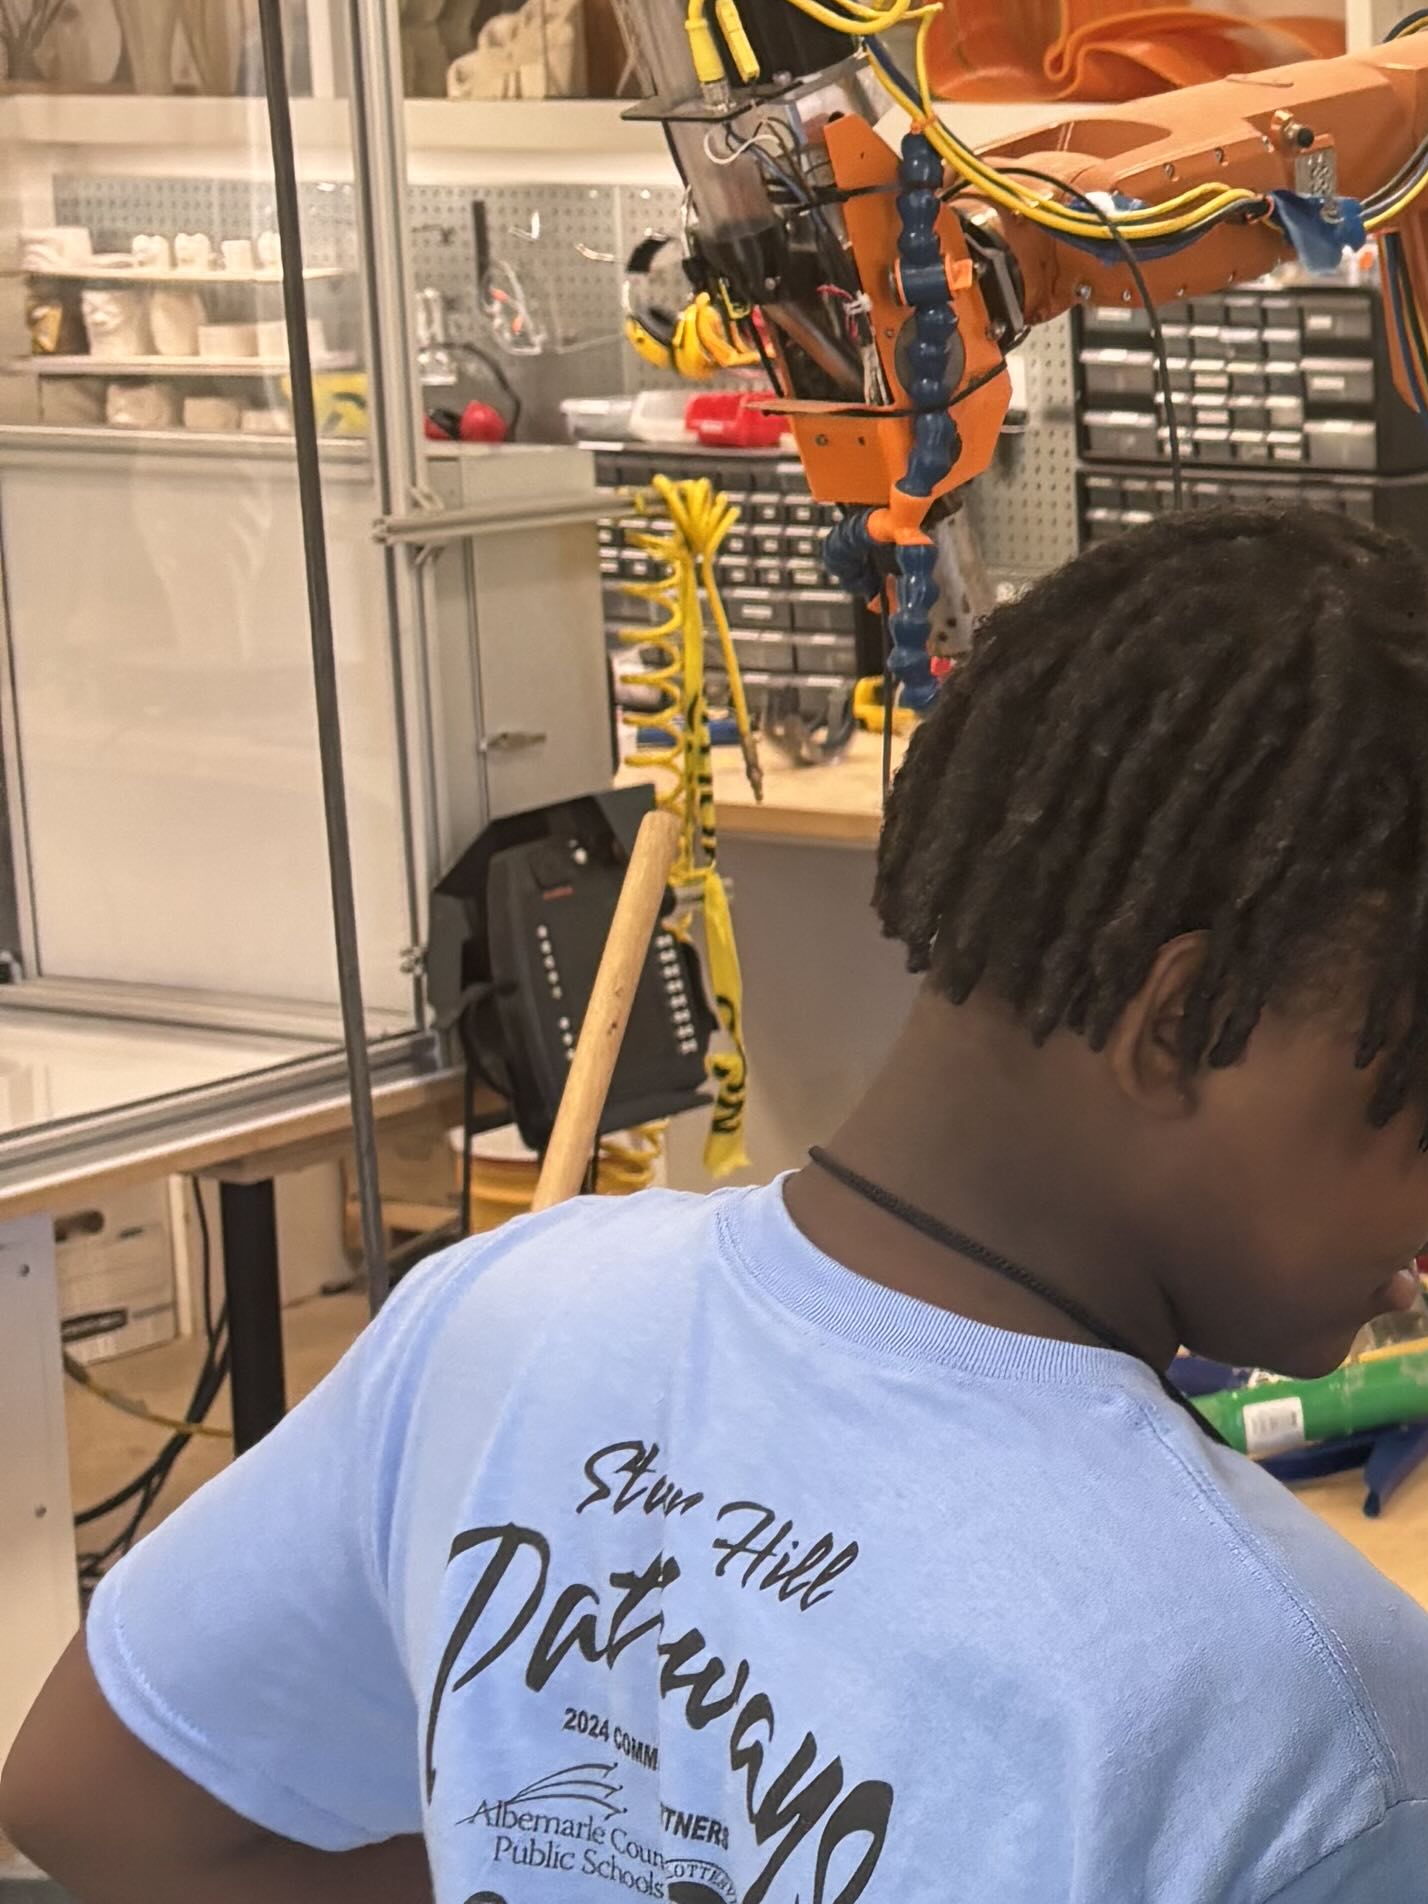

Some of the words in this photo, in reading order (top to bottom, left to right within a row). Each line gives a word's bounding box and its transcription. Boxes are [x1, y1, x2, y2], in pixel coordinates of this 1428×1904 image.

[713, 1501, 859, 1612] Hill
[563, 1707, 610, 1743] 2024
[466, 1799, 606, 1845] Albemarle
[493, 1835, 575, 1872] Public
[581, 1847, 665, 1900] Schools
